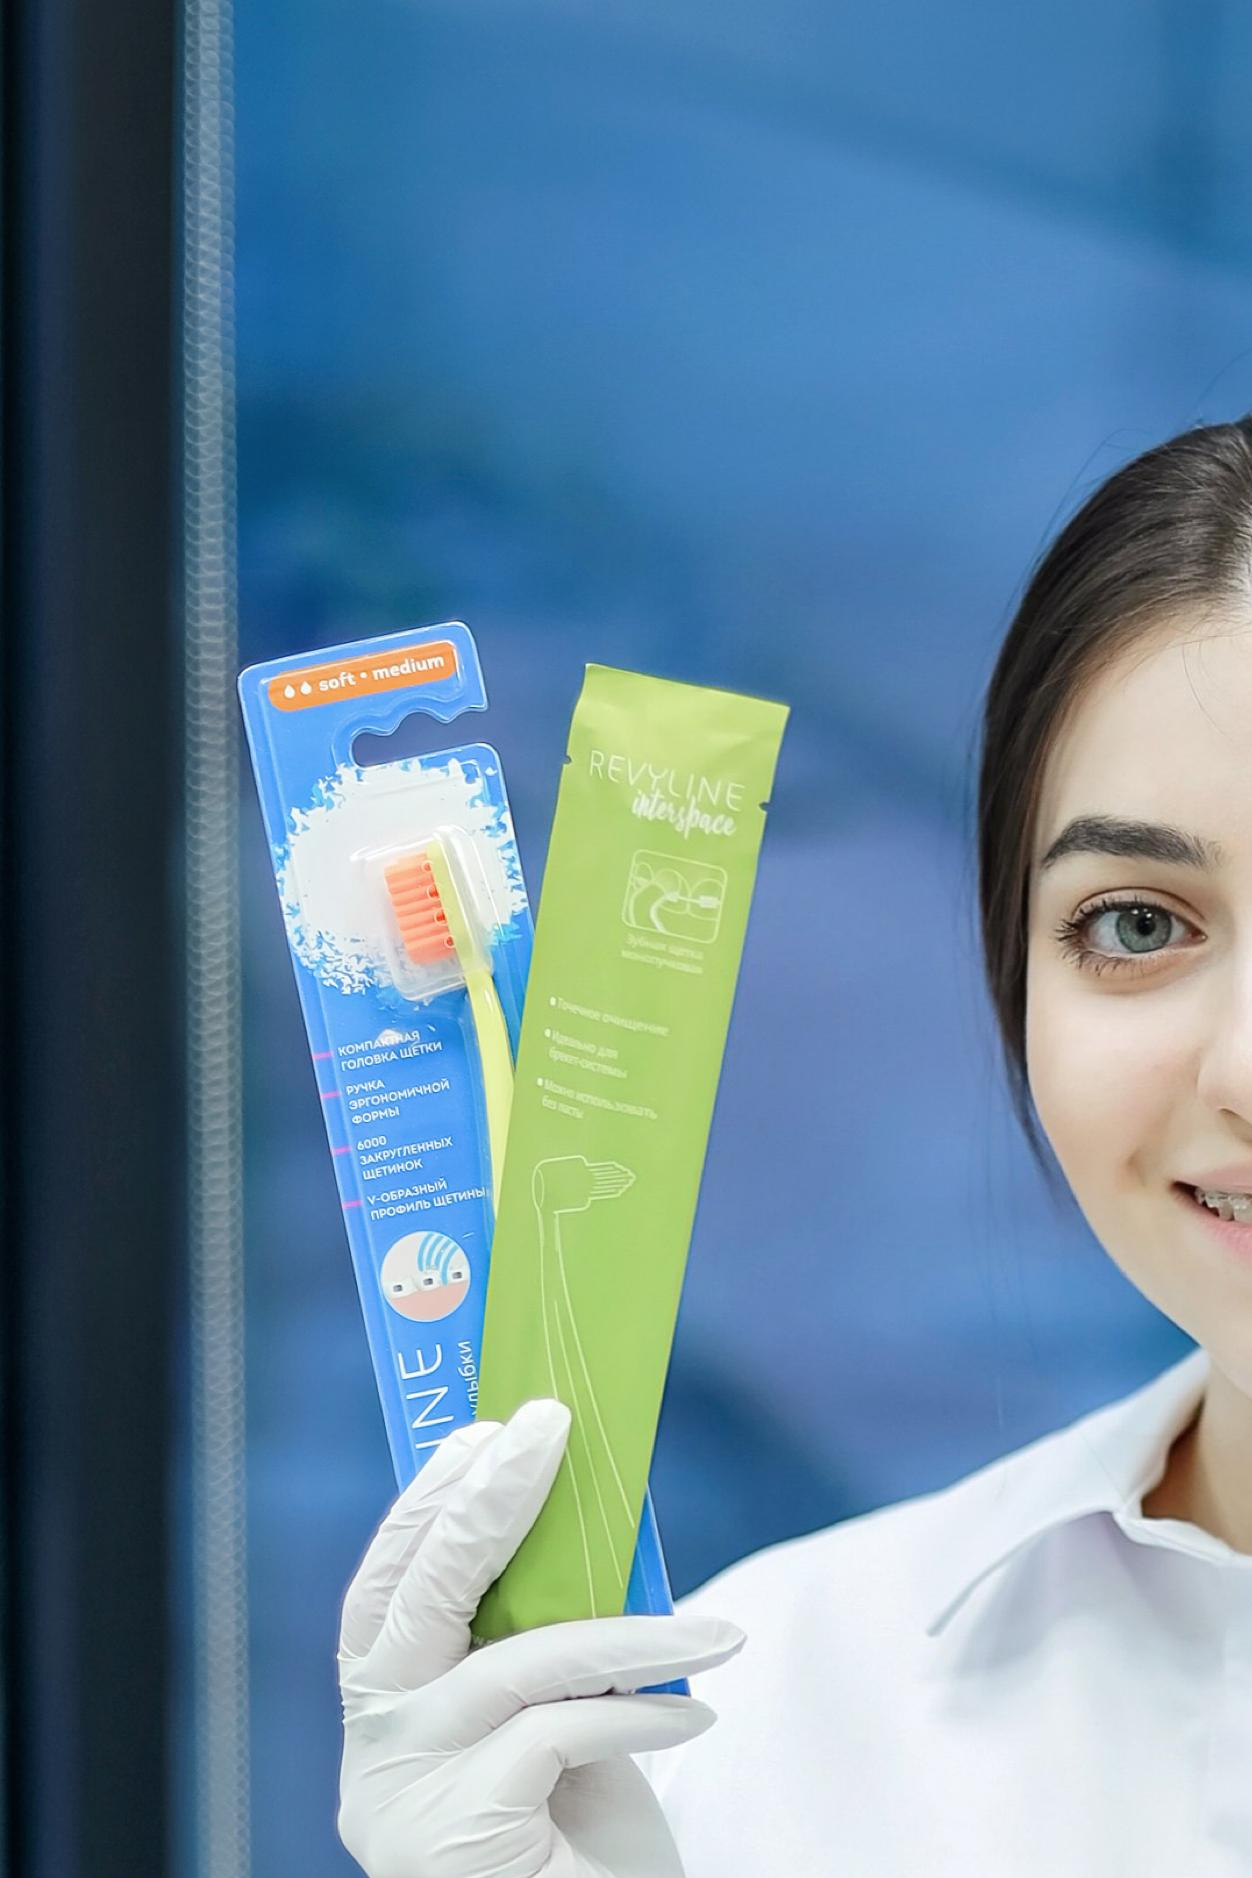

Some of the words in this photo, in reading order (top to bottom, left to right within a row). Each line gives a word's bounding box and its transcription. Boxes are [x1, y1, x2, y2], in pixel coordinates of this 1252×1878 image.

[319, 671, 356, 692] soft
[372, 655, 445, 681] medium
[590, 750, 745, 812] REVYLINE
[631, 788, 736, 840] interspace
[338, 1030, 421, 1057] КОМПАКТНАЯ
[341, 1051, 398, 1071] ГОЛОВКА
[346, 1079, 385, 1096] РУЧКА
[348, 1078, 450, 1110] ЭРГОНОМИЧНОЙ
[351, 1106, 400, 1124] ФОРМЫ
[357, 1135, 387, 1151] 6000
[359, 1136, 454, 1166] ЗАКРУГЛЕННЫХ
[362, 1158, 424, 1180] ЩЕТИНОК
[367, 1177, 449, 1205] V-ОБРАЗНЫЙ
[370, 1199, 431, 1221] ПРОФИЛЬ
[433, 1186, 486, 1207] ЩЕТИНЫ
